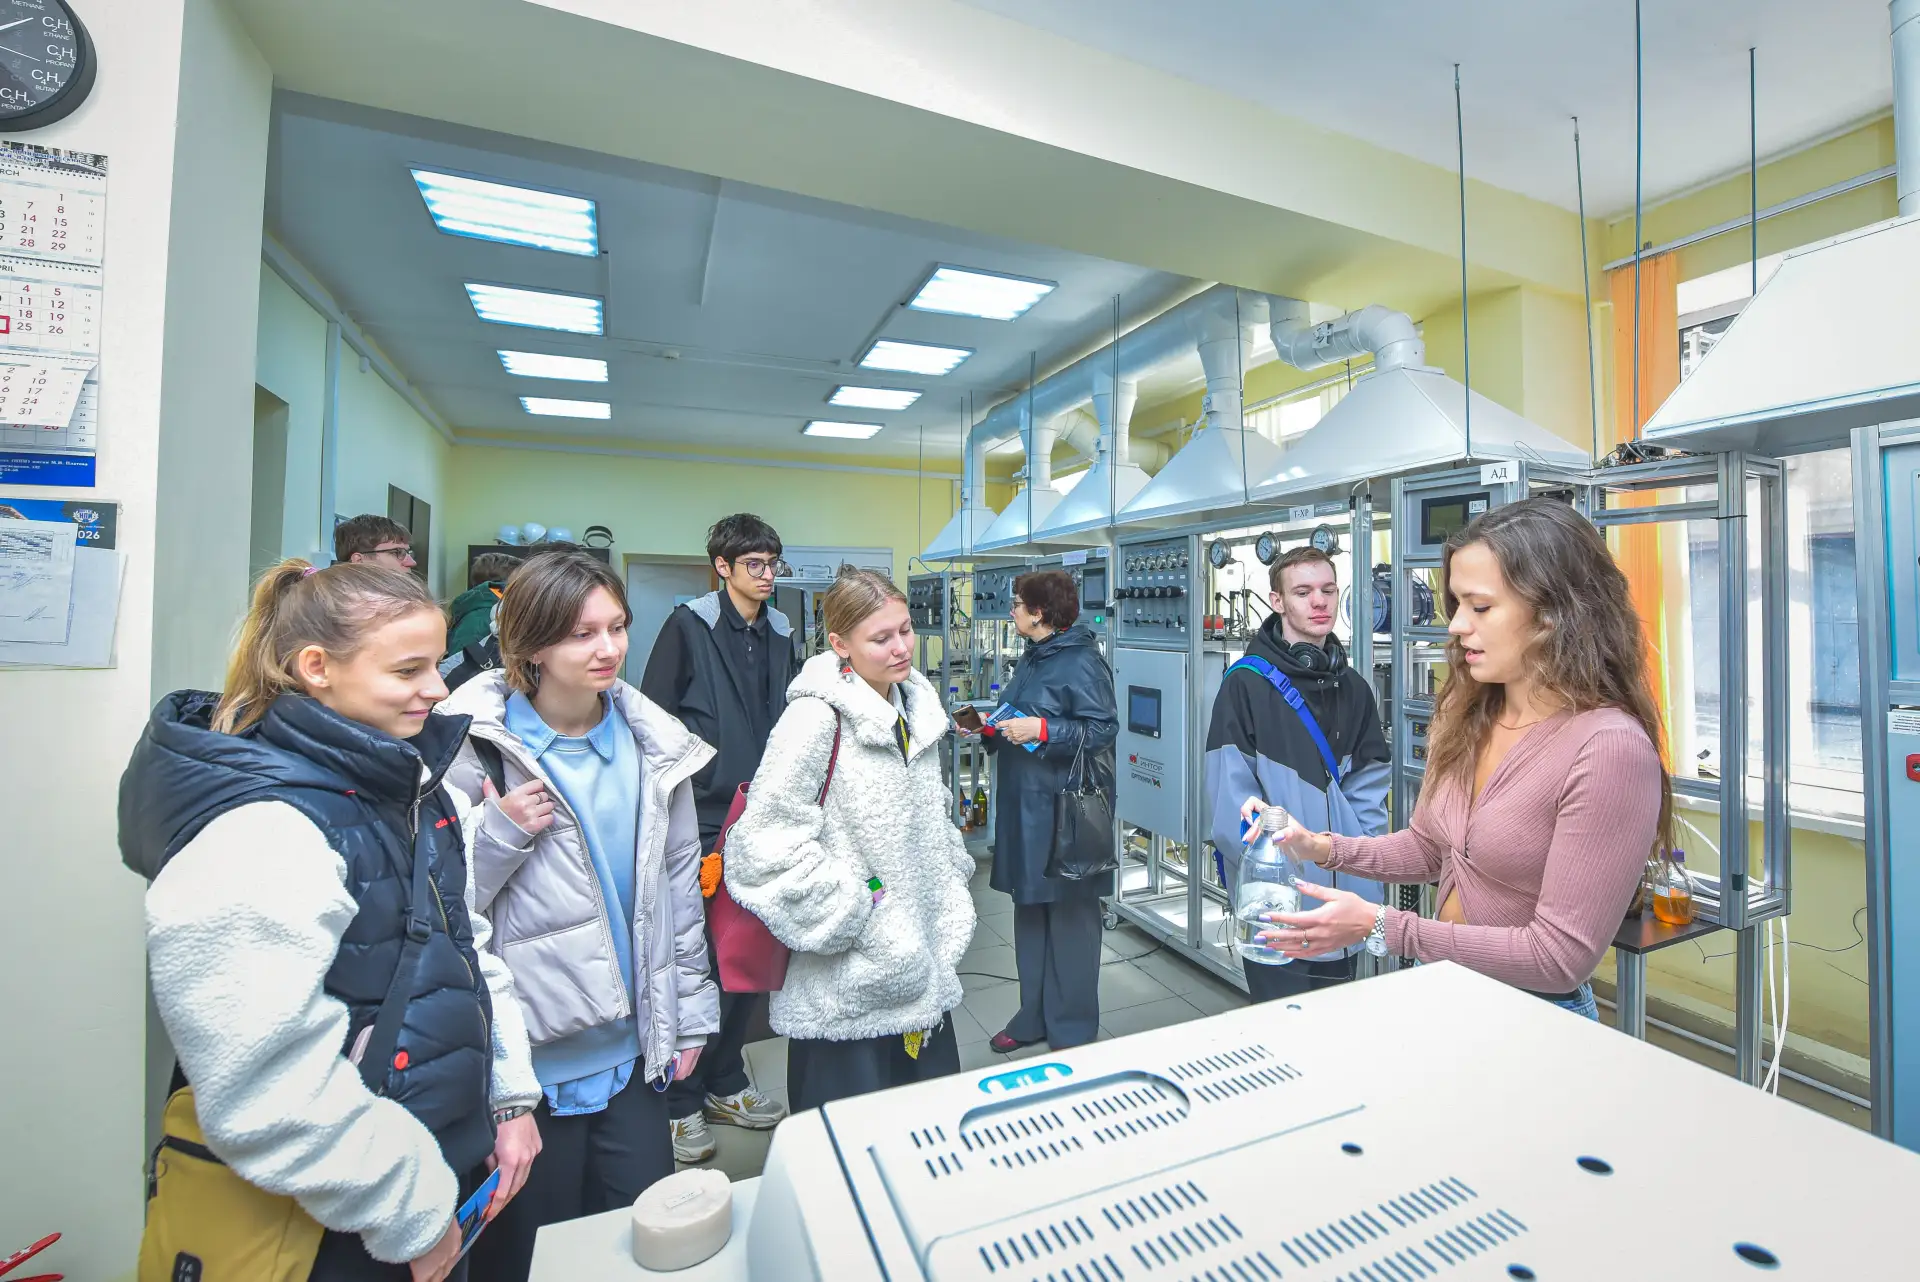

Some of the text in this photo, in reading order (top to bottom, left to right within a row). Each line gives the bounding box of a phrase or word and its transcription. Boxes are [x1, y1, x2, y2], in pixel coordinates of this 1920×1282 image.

[43, 31, 70, 41] ETHANE
[45, 59, 75, 69] PROPAN
[27, 201, 34, 209] 7
[57, 205, 65, 214] 8
[22, 213, 37, 223] 14
[53, 217, 68, 227] 15
[20, 225, 34, 235] 21
[51, 229, 67, 239] 22
[19, 238, 35, 248] 28
[50, 242, 66, 251] 29
[22, 284, 31, 293] 4
[54, 287, 62, 296] 5
[19, 296, 32, 306] 11
[51, 300, 65, 309] 12
[18, 309, 33, 319] 18
[50, 312, 65, 321] 19
[16, 321, 33, 331] 25
[48, 325, 64, 334] 26
[28, 387, 42, 395] 17
[22, 397, 38, 405] 24
[18, 407, 32, 416] 31
[1490, 467, 1508, 480] АД
[77, 530, 100, 540] 026
